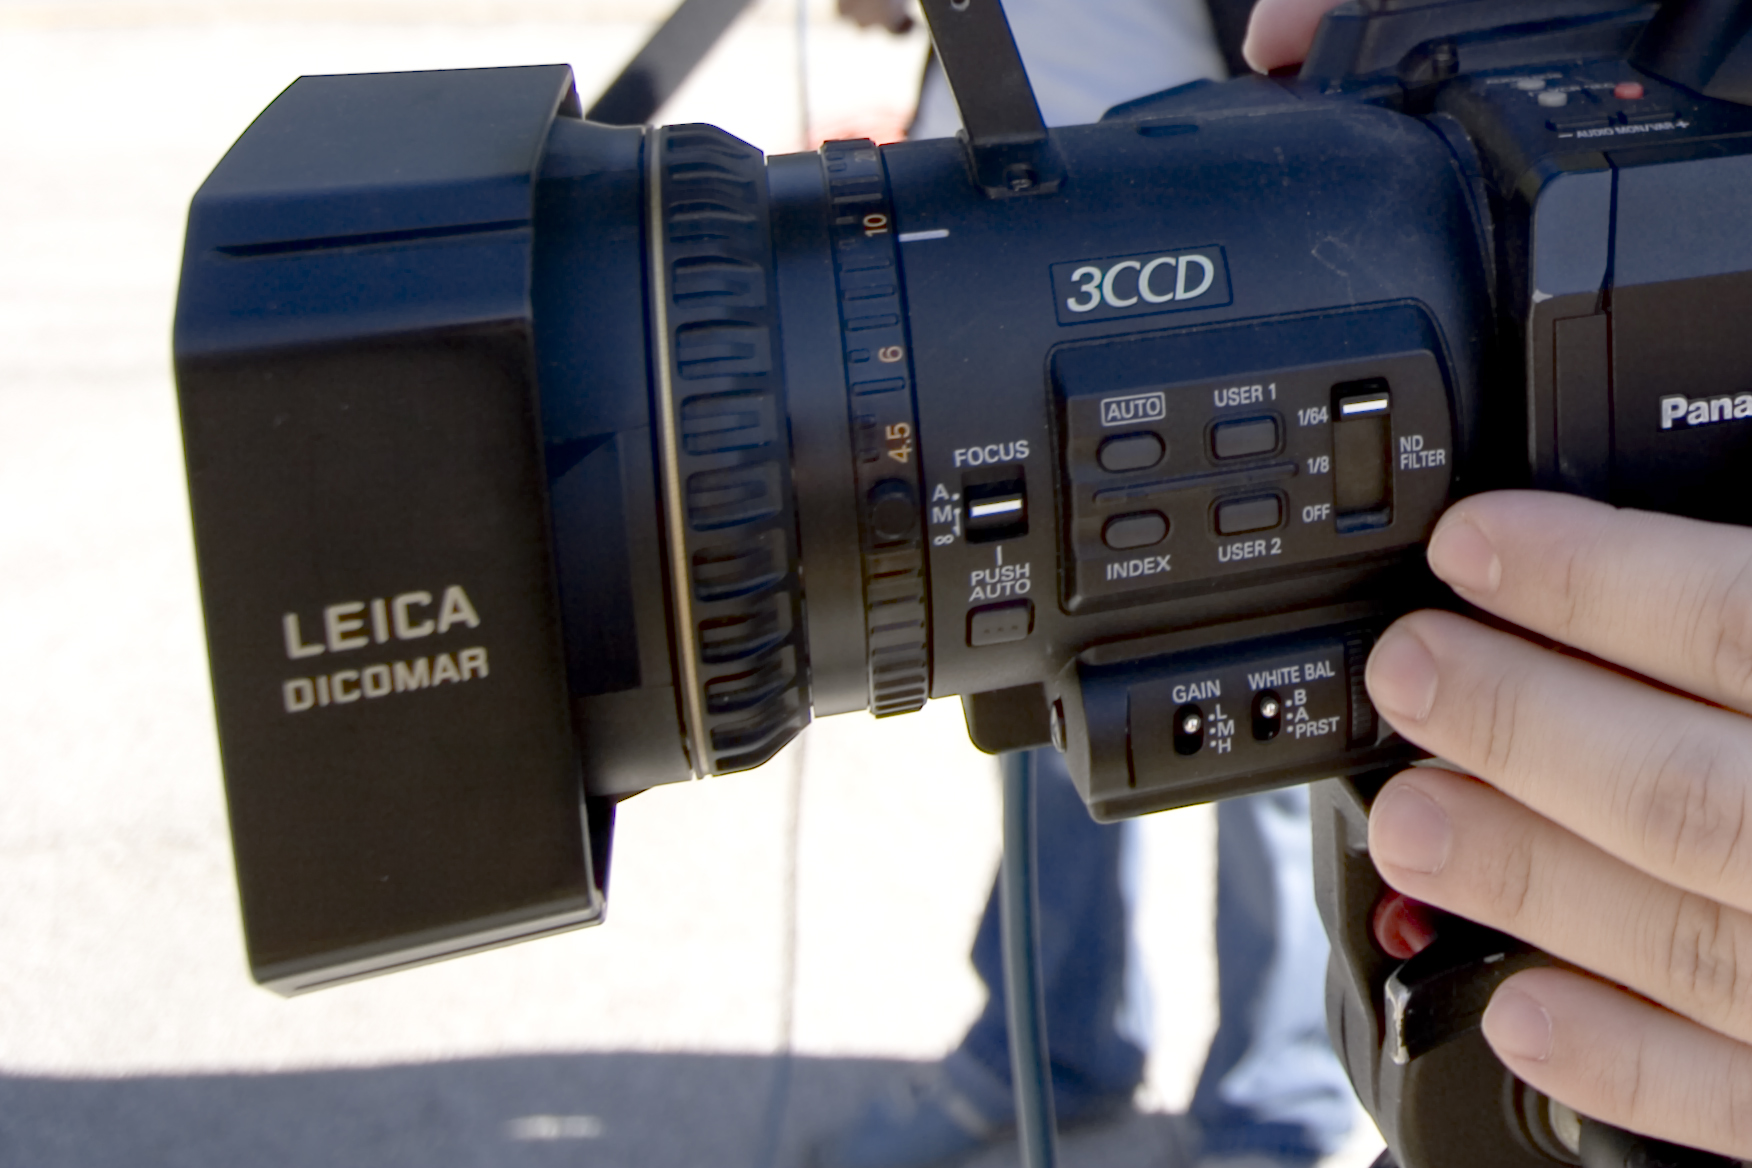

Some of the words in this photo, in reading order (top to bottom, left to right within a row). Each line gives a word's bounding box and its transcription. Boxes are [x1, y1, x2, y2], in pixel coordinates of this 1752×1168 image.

[1576, 127, 1614, 138] AUDIO
[863, 213, 888, 239] 10
[1066, 254, 1215, 312] 3CCD
[877, 345, 904, 364] 6
[1214, 385, 1263, 407] USER
[1268, 383, 1277, 401] 1
[1107, 398, 1160, 421] AUTO
[1298, 406, 1329, 426] 1/64
[885, 422, 912, 463] 4.5
[954, 440, 1030, 468] FOCUS
[1400, 435, 1424, 452] ND
[1307, 457, 1330, 474] 1/8
[1400, 450, 1446, 471] FILTER
[932, 505, 953, 523] M
[1302, 504, 1331, 523] OFF
[1218, 540, 1267, 563] USER
[1270, 538, 1282, 556] 2
[971, 562, 1030, 586] PUSH
[1106, 555, 1171, 581] INDEX
[969, 578, 1031, 602] AUTO
[283, 584, 480, 660] LEICA
[282, 646, 489, 713] DICOMAR
[1248, 666, 1300, 691] WHITE
[1305, 661, 1335, 680] BAL
[1172, 679, 1221, 703] GAIN
[1295, 716, 1340, 739] PRST
